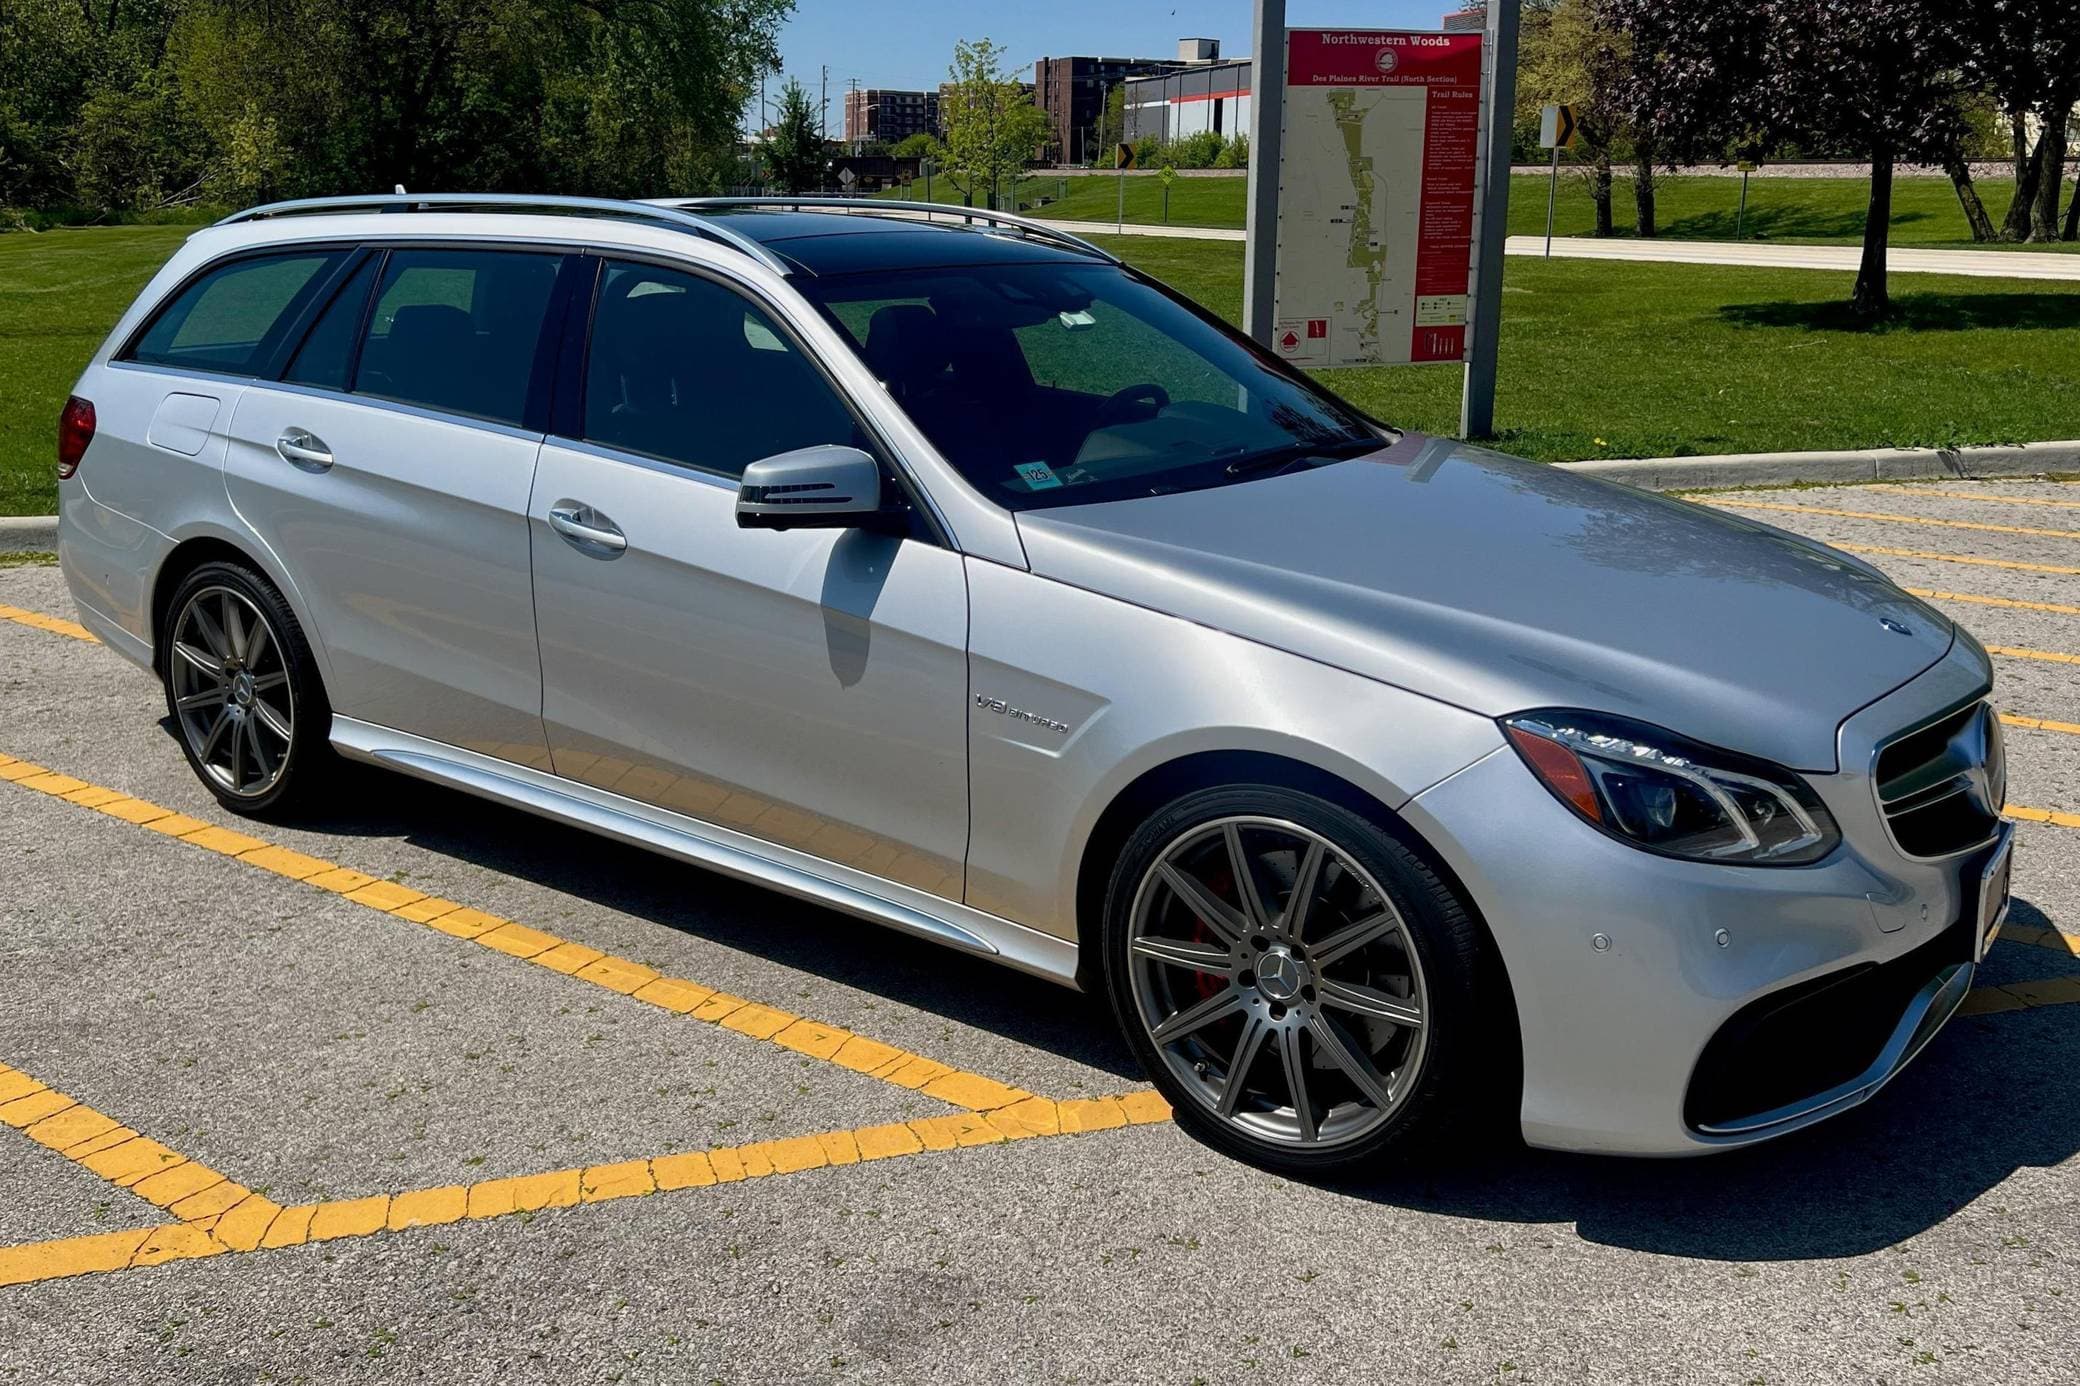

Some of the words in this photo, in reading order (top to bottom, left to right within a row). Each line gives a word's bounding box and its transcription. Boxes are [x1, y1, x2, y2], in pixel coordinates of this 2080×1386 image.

[1322, 33, 1406, 45] Northwestern
[1410, 36, 1450, 46] Woods
[1312, 74, 1327, 82] Des
[1401, 75, 1425, 83] (North
[1426, 75, 1457, 84] Section)
[976, 693, 1007, 714] V8
[1008, 707, 1069, 734] BITURBO
